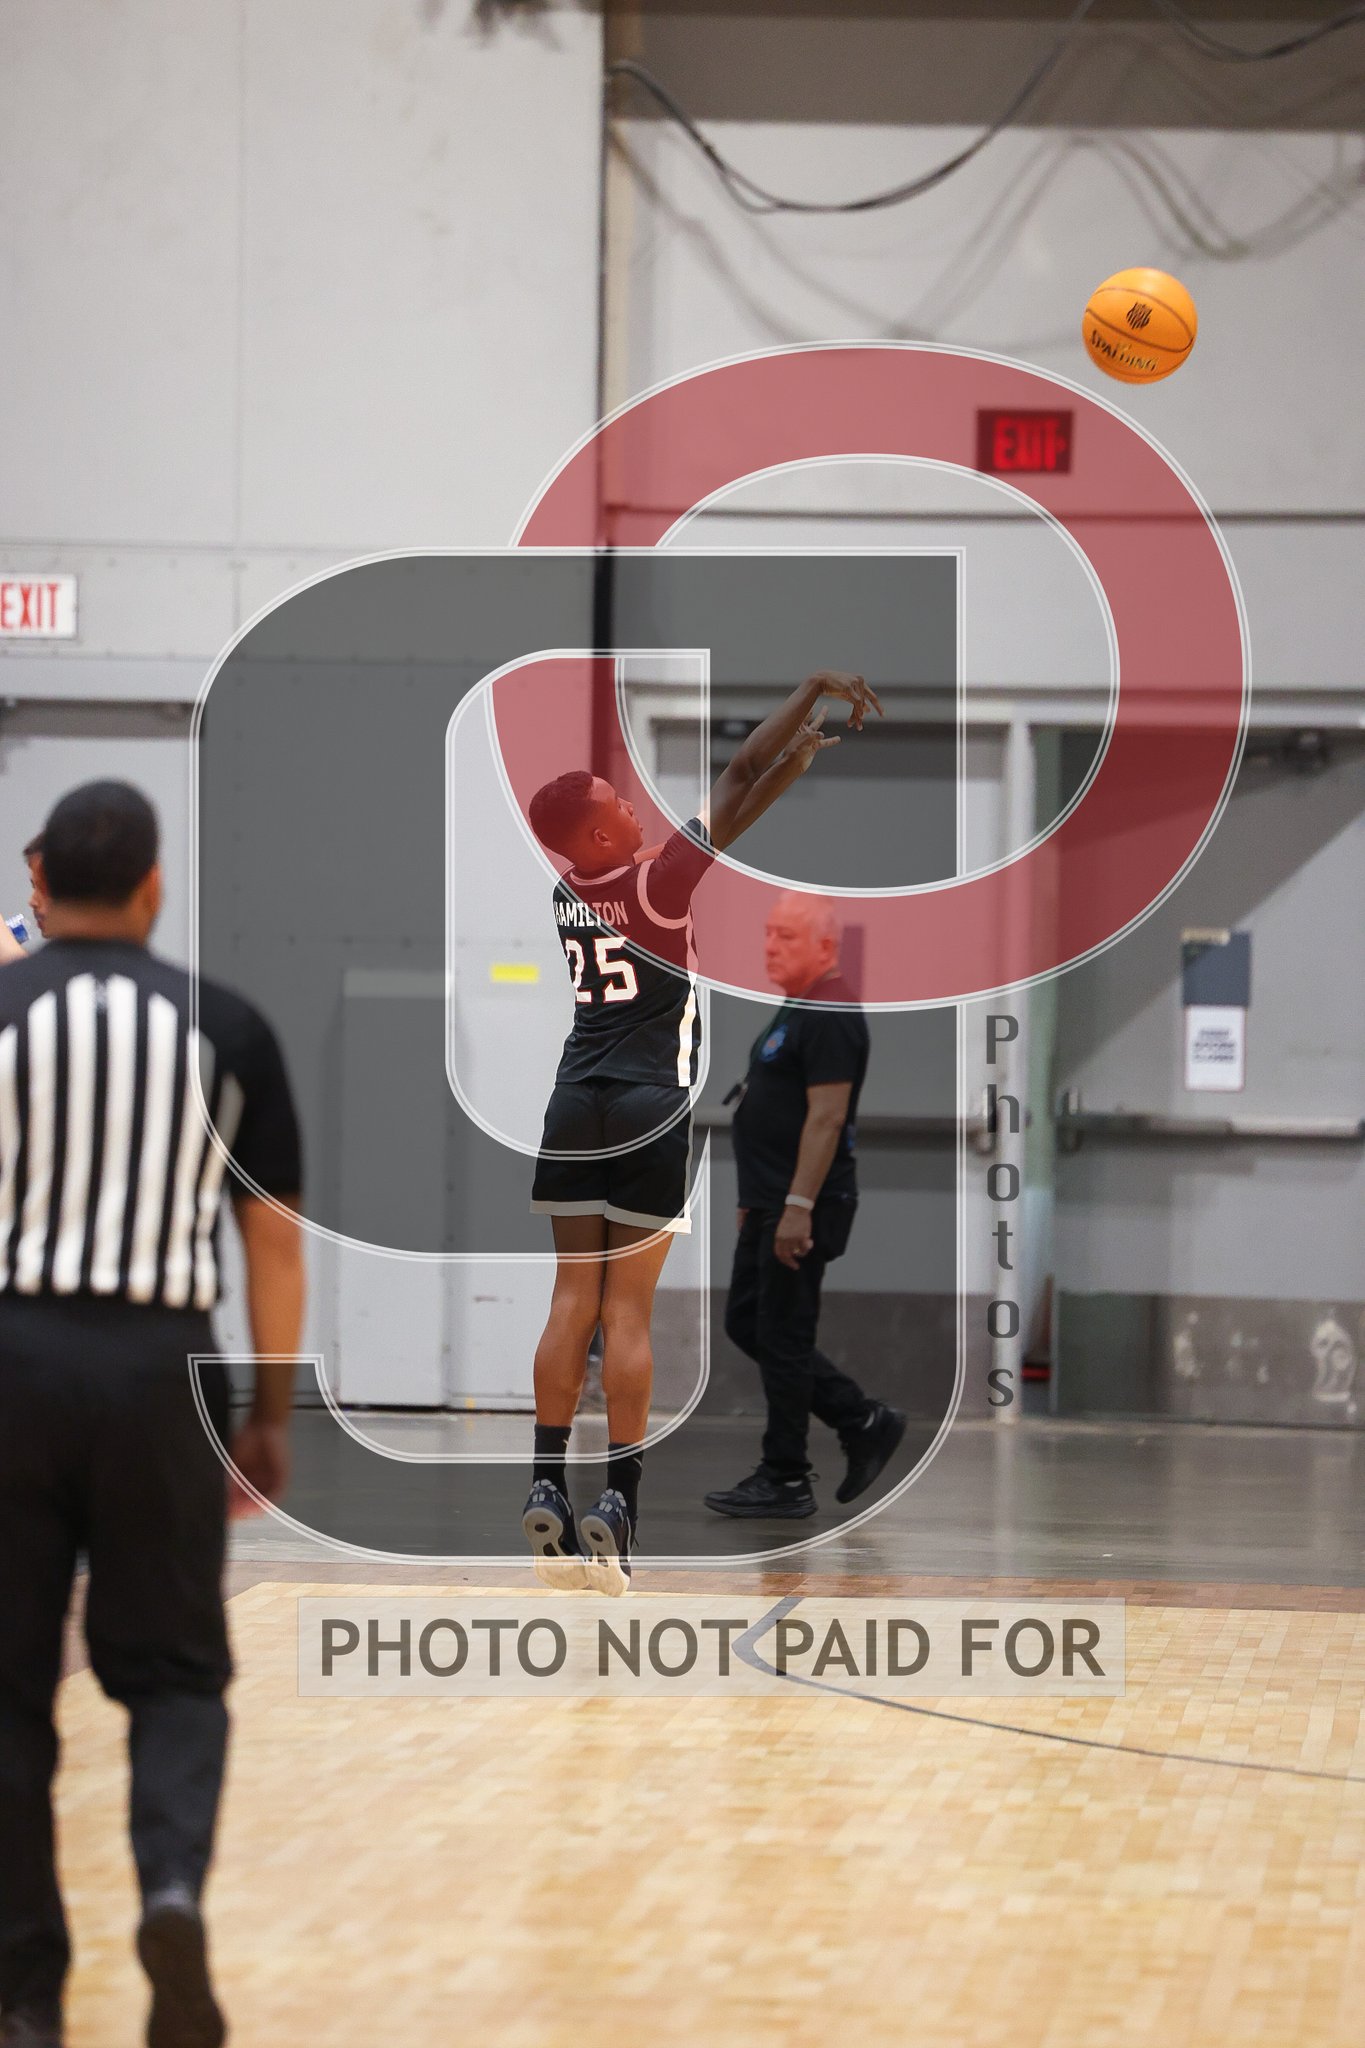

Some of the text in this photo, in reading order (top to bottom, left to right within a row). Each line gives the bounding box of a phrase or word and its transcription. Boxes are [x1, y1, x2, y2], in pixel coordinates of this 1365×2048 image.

[1090, 328, 1160, 373] SPALDING
[0, 582, 60, 629] EXIT
[553, 900, 629, 928] HAMILTON
[565, 936, 640, 1004] 25
